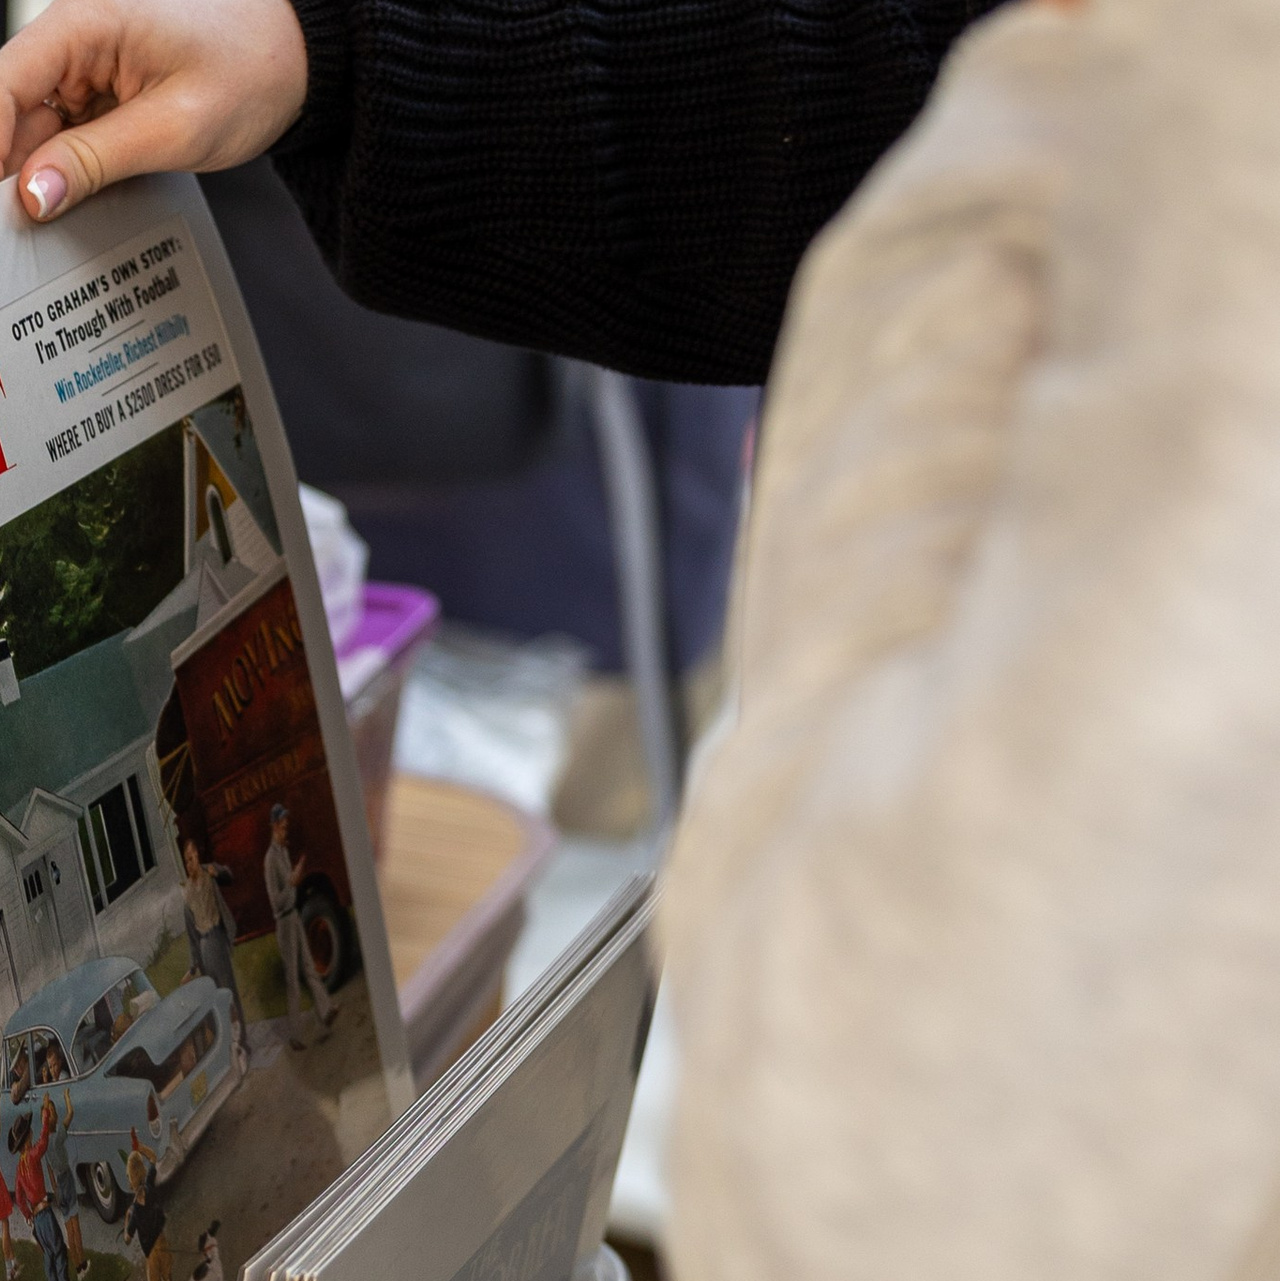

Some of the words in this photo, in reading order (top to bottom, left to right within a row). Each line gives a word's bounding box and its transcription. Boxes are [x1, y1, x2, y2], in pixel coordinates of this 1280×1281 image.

[11, 311, 44, 341] OTTO
[46, 274, 110, 323] GRAHAM'S
[112, 257, 139, 290] OWN
[141, 236, 183, 269] STORY:
[35, 340, 58, 364] I'm
[55, 309, 107, 352] Through
[104, 293, 135, 330] With
[133, 266, 181, 309] Football
[45, 425, 83, 463] WHERE
[80, 417, 96, 442] TO
[95, 404, 116, 437] BUY
[117, 399, 127, 422] A
[125, 382, 156, 418] $2500
[154, 363, 186, 398] DRESS
[183, 352, 206, 381] FOR
[202, 343, 222, 370] $50
[54, 379, 75, 404] Win
[73, 352, 127, 392] Rockefeller,
[123, 328, 158, 365] Richest
